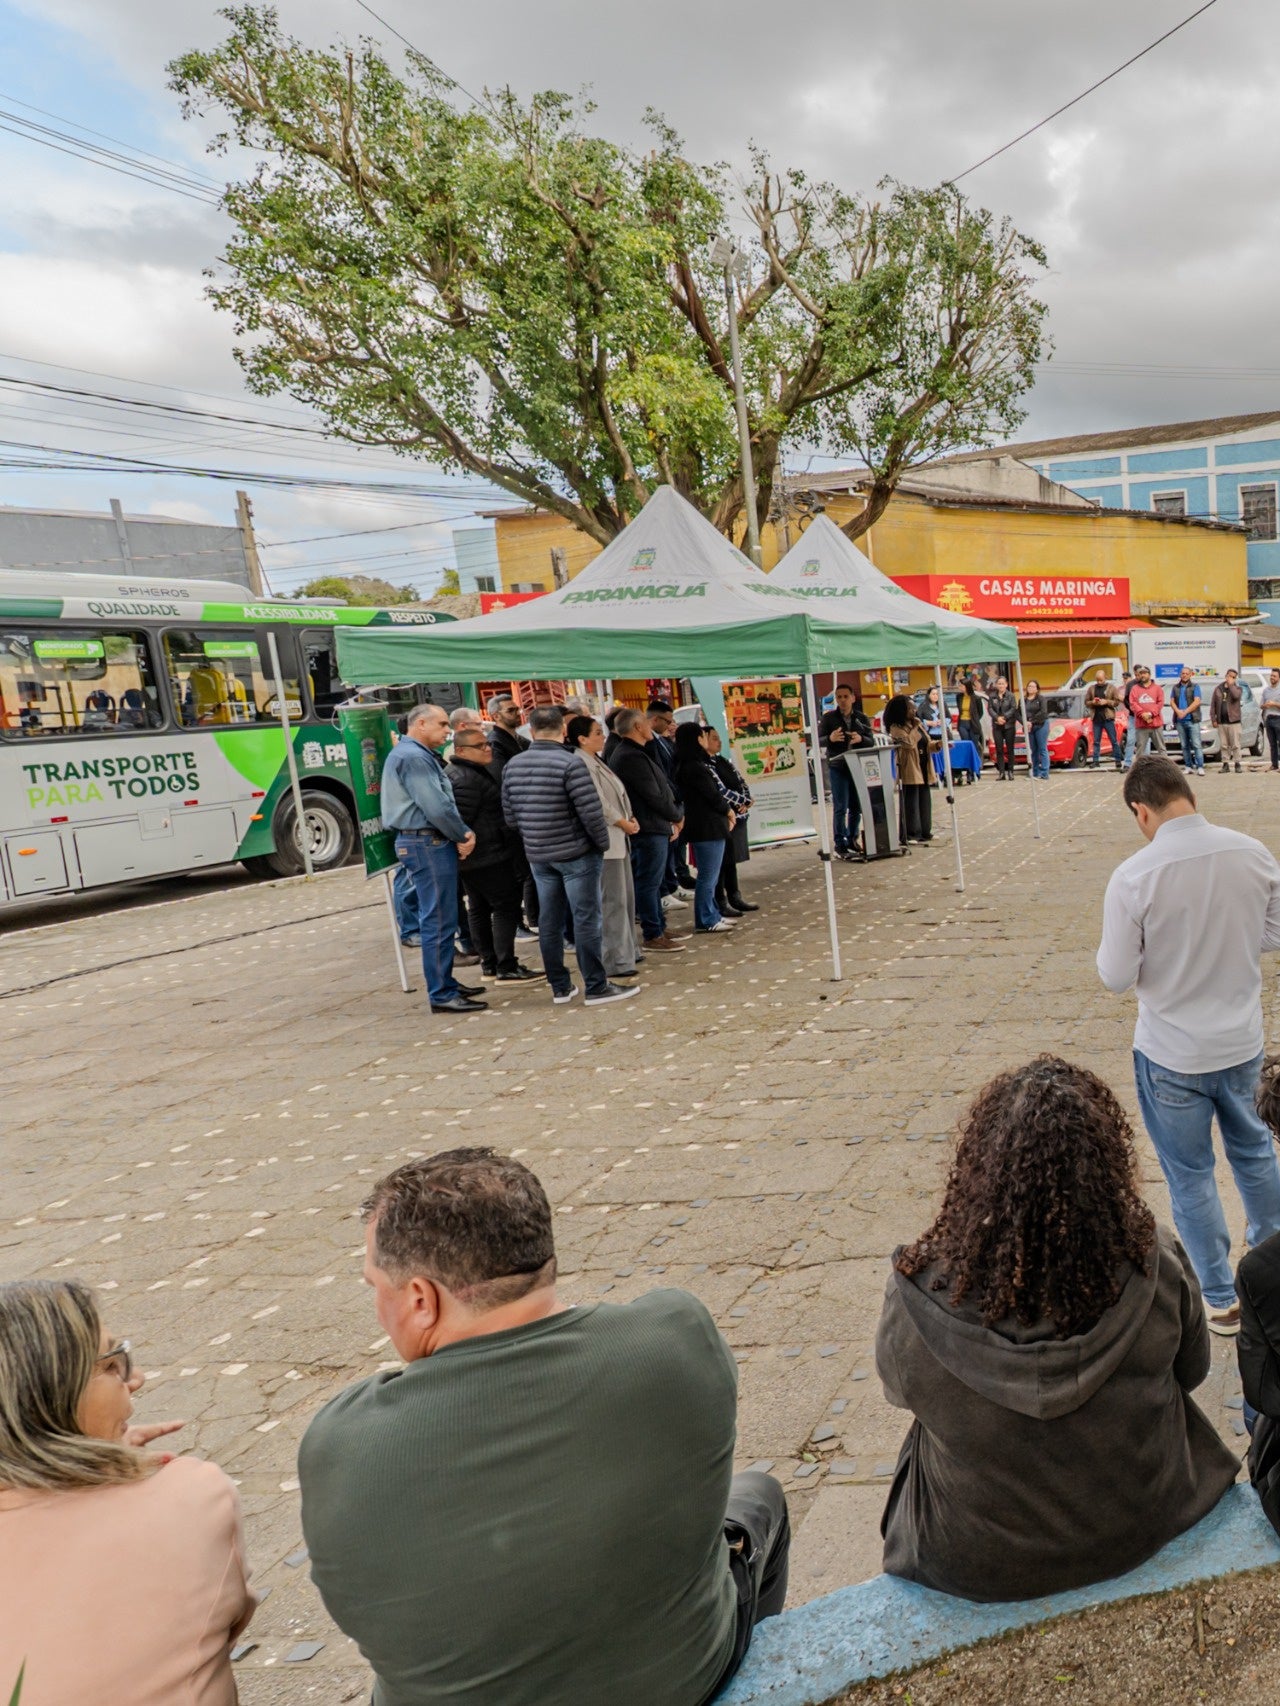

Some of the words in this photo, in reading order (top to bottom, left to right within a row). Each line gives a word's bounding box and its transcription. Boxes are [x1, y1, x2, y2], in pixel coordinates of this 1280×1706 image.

[118, 586, 190, 598] SPHEROS
[559, 582, 711, 605] PARANAGUÁ
[979, 579, 1035, 596] CASAS
[1039, 578, 1117, 596] MARINGÁ
[87, 601, 181, 617] QUALIDADE
[1011, 597, 1047, 606] MEGA
[1049, 597, 1086, 606] STORE
[243, 607, 339, 621] ACESSIBILIDADE
[389, 612, 436, 624] RESPEITO
[23, 751, 197, 784] TRANSPORTE
[27, 782, 104, 809] PARA
[108, 772, 200, 800] TODOS
